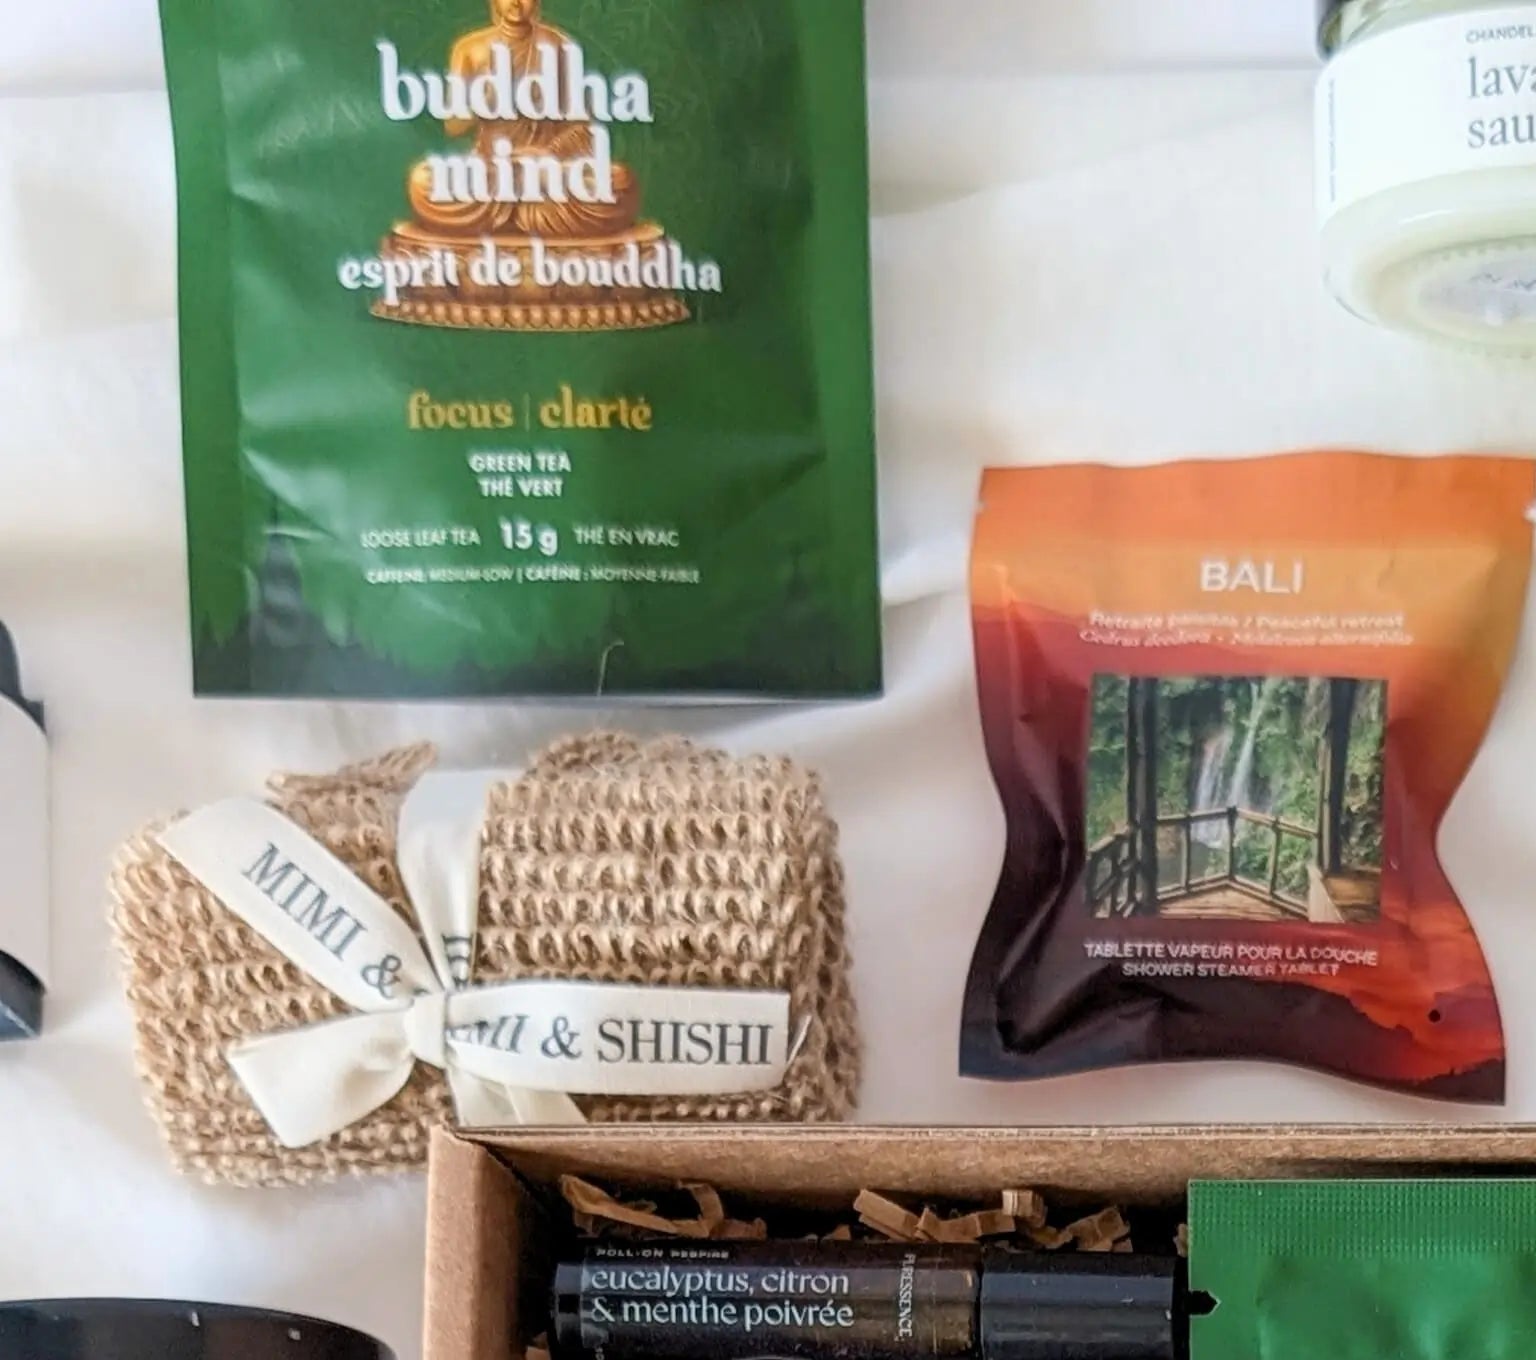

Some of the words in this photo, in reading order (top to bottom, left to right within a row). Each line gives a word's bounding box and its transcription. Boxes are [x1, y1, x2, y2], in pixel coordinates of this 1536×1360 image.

[375, 39, 654, 125] buddha
[426, 128, 617, 204] mind
[339, 247, 458, 304] esprit
[469, 238, 522, 289] de
[532, 240, 722, 293] bouddha
[408, 389, 513, 430] focus
[540, 384, 653, 430] clarté
[469, 452, 531, 472] GREEN
[536, 452, 571, 472] TEA
[479, 477, 513, 497] THÉ
[519, 478, 563, 497] VERT
[1201, 560, 1304, 595] BALI
[242, 842, 368, 962] MIMI
[359, 953, 403, 998] &
[1084, 942, 1165, 960] TABLETTE
[1167, 943, 1233, 960] VAPEUR
[1237, 943, 1281, 961] POUR
[1285, 944, 1307, 961] LA
[1310, 947, 1378, 967] DOUCHE
[541, 1017, 581, 1059] &
[597, 1019, 774, 1066] SHISHI
[591, 1266, 754, 1297] eucalyptus,
[762, 1272, 849, 1294] citron
[592, 1297, 615, 1322] &
[623, 1298, 738, 1324] menthe
[744, 1298, 854, 1332] poivrée
